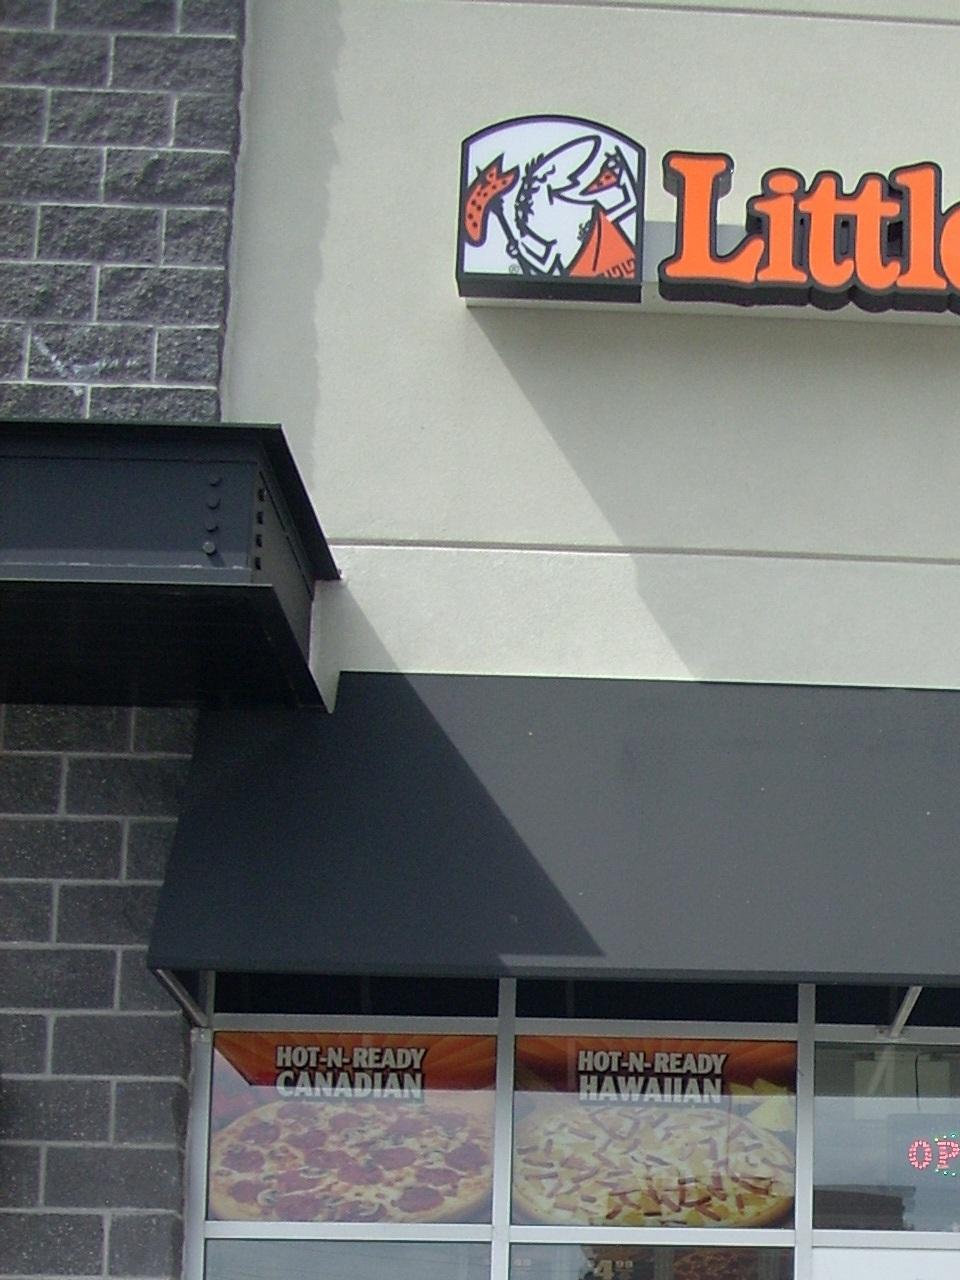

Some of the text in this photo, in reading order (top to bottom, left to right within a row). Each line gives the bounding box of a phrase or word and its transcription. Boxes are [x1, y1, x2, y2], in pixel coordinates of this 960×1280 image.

[275, 1045, 426, 1071] HOT-N-READY
[577, 1049, 728, 1076] HOT-N-READY
[275, 1070, 423, 1099] CANADIAN
[578, 1075, 722, 1104] HAWAIIAN
